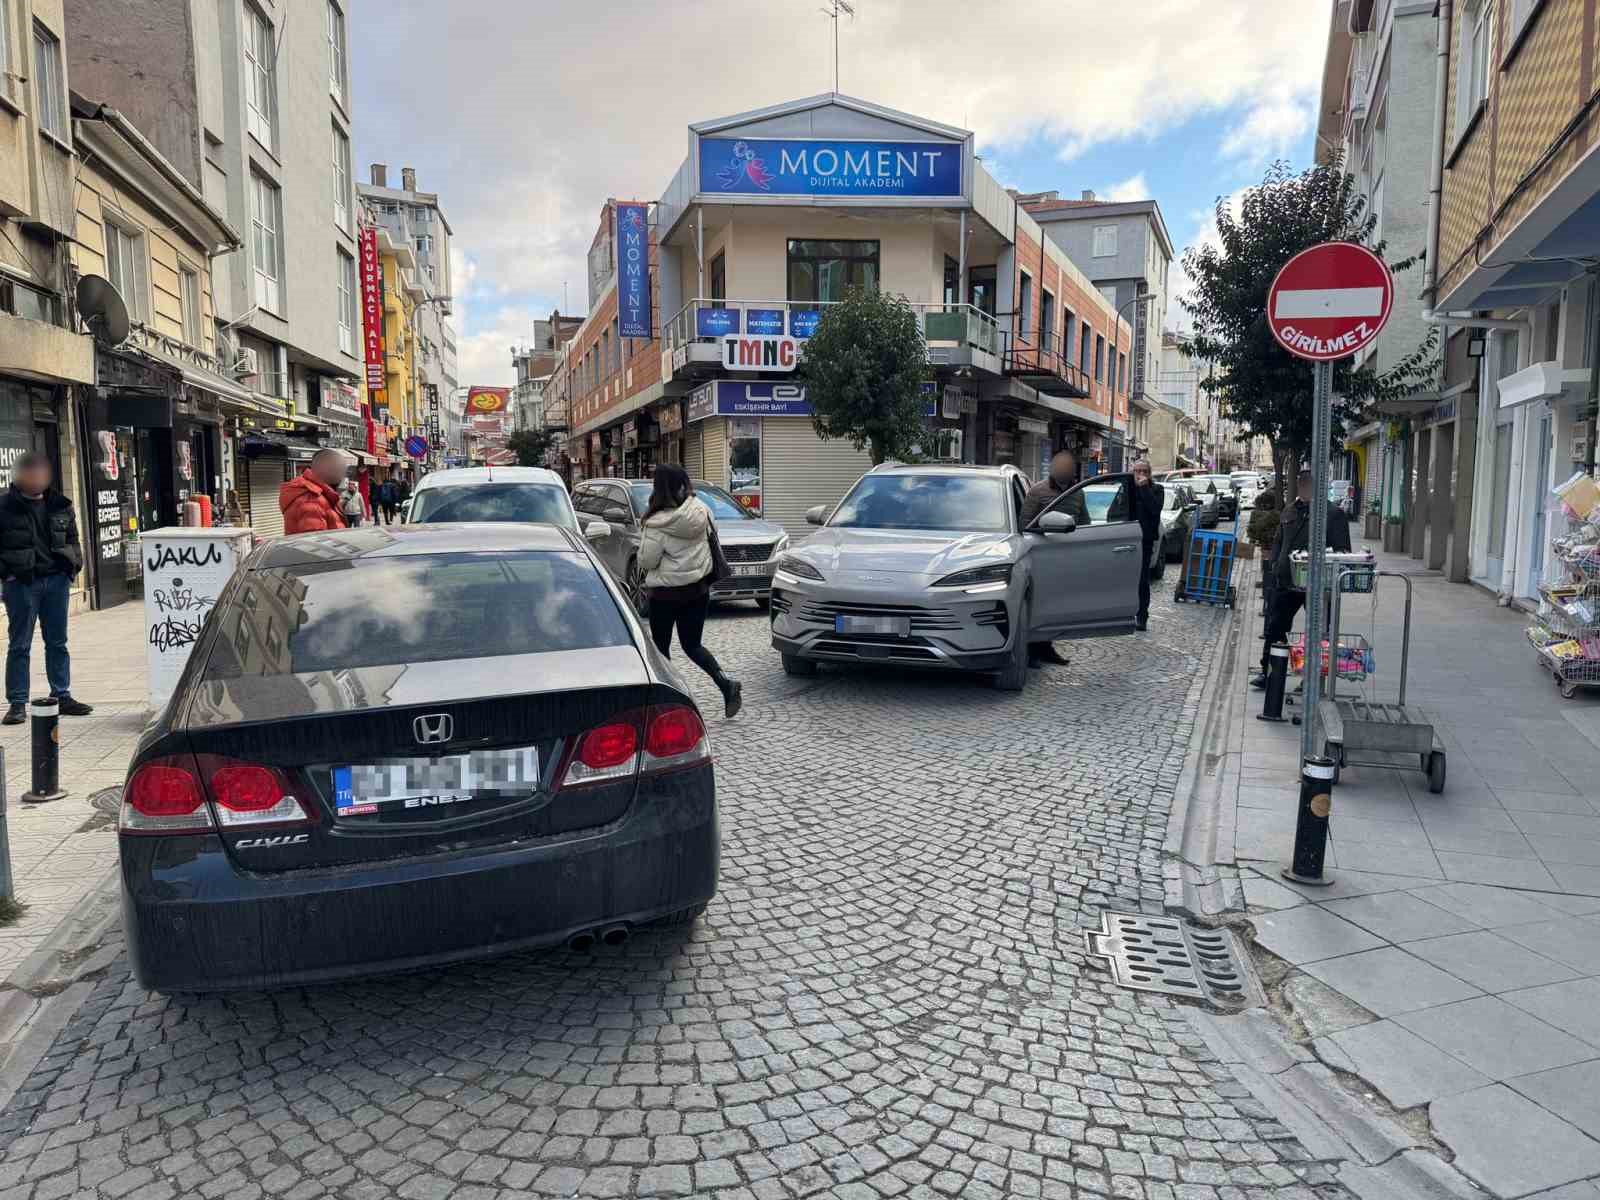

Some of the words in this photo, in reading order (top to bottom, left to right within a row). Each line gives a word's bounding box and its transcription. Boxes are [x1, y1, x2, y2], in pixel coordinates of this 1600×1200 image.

[779, 148, 942, 177] MOMENT
[626, 233, 641, 322] MOMENT
[1279, 322, 1373, 353] GİRİLMEZ
[725, 338, 794, 367] TMNC
[234, 834, 309, 850] CIVIC
